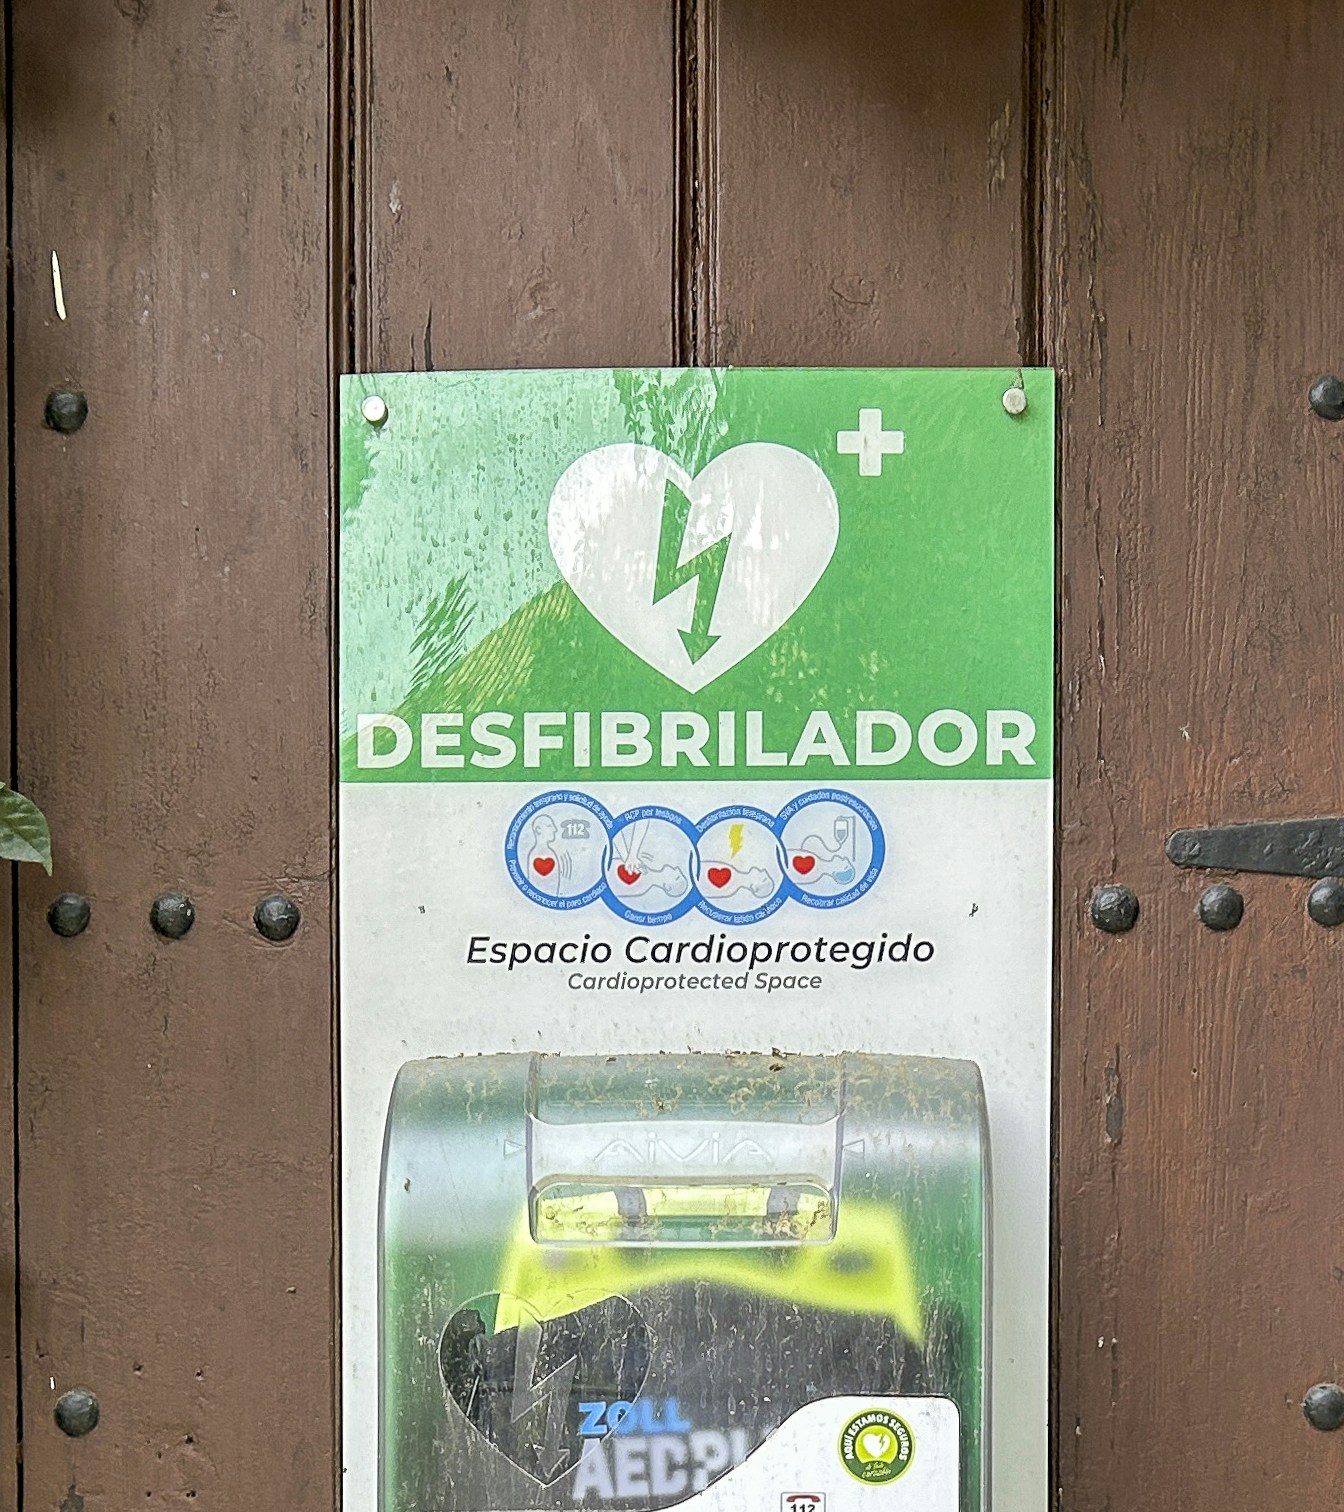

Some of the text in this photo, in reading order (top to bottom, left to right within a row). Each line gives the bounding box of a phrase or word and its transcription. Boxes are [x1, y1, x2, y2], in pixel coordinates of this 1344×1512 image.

[356, 710, 1037, 769] DESFIBRILADOR
[467, 933, 934, 970] Espacio Cardioprotegido
[568, 972, 822, 993] Cardioprotected Space
[578, 1397, 692, 1436] ZOLL
[848, 1414, 890, 1437] ESTAMOS
[888, 1418, 910, 1461] SEGUROS
